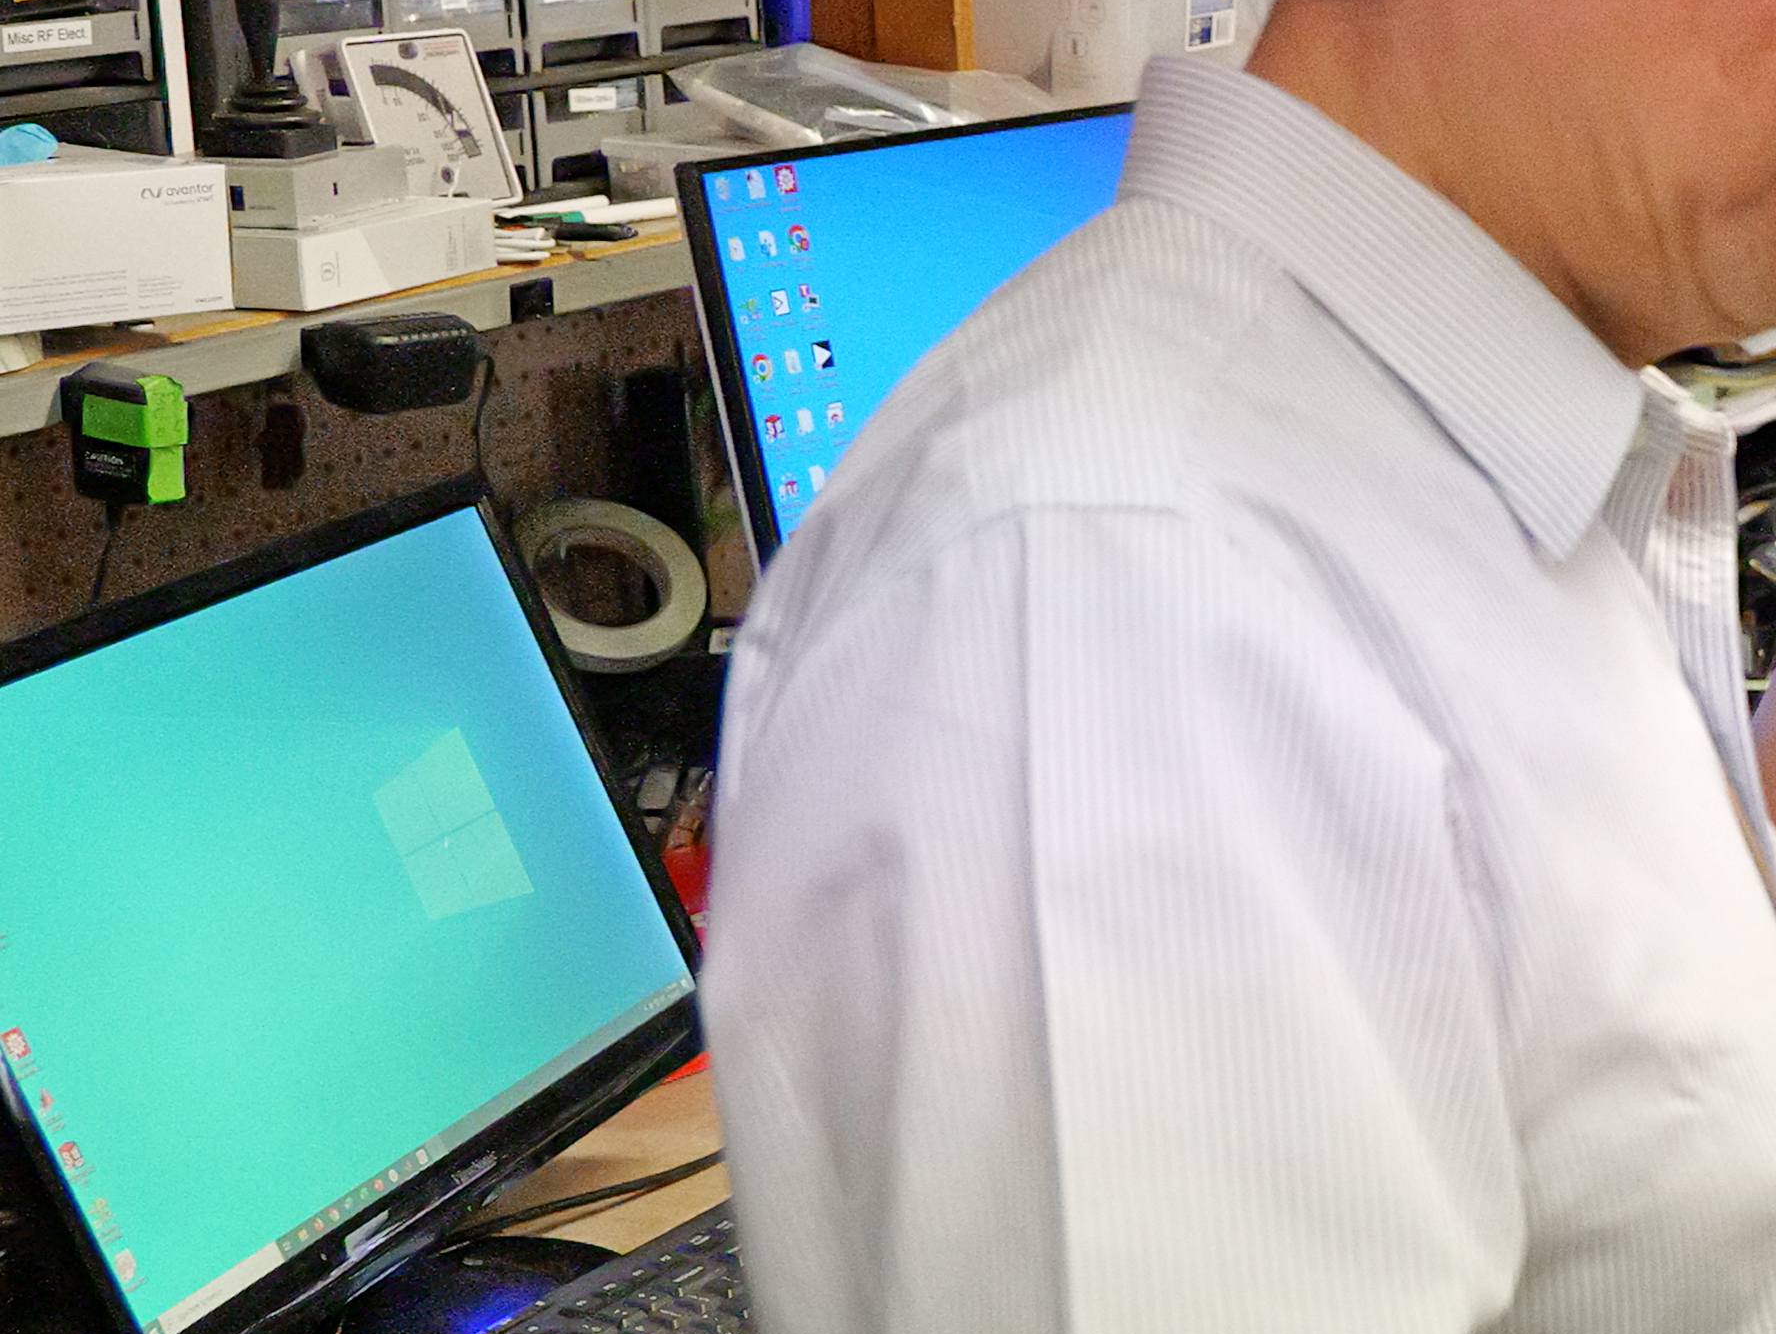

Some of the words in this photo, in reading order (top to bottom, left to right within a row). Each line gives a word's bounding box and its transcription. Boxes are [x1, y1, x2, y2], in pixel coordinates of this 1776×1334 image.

[7, 31, 35, 46] Misc
[37, 28, 54, 42] RF
[166, 183, 216, 196] avantor
